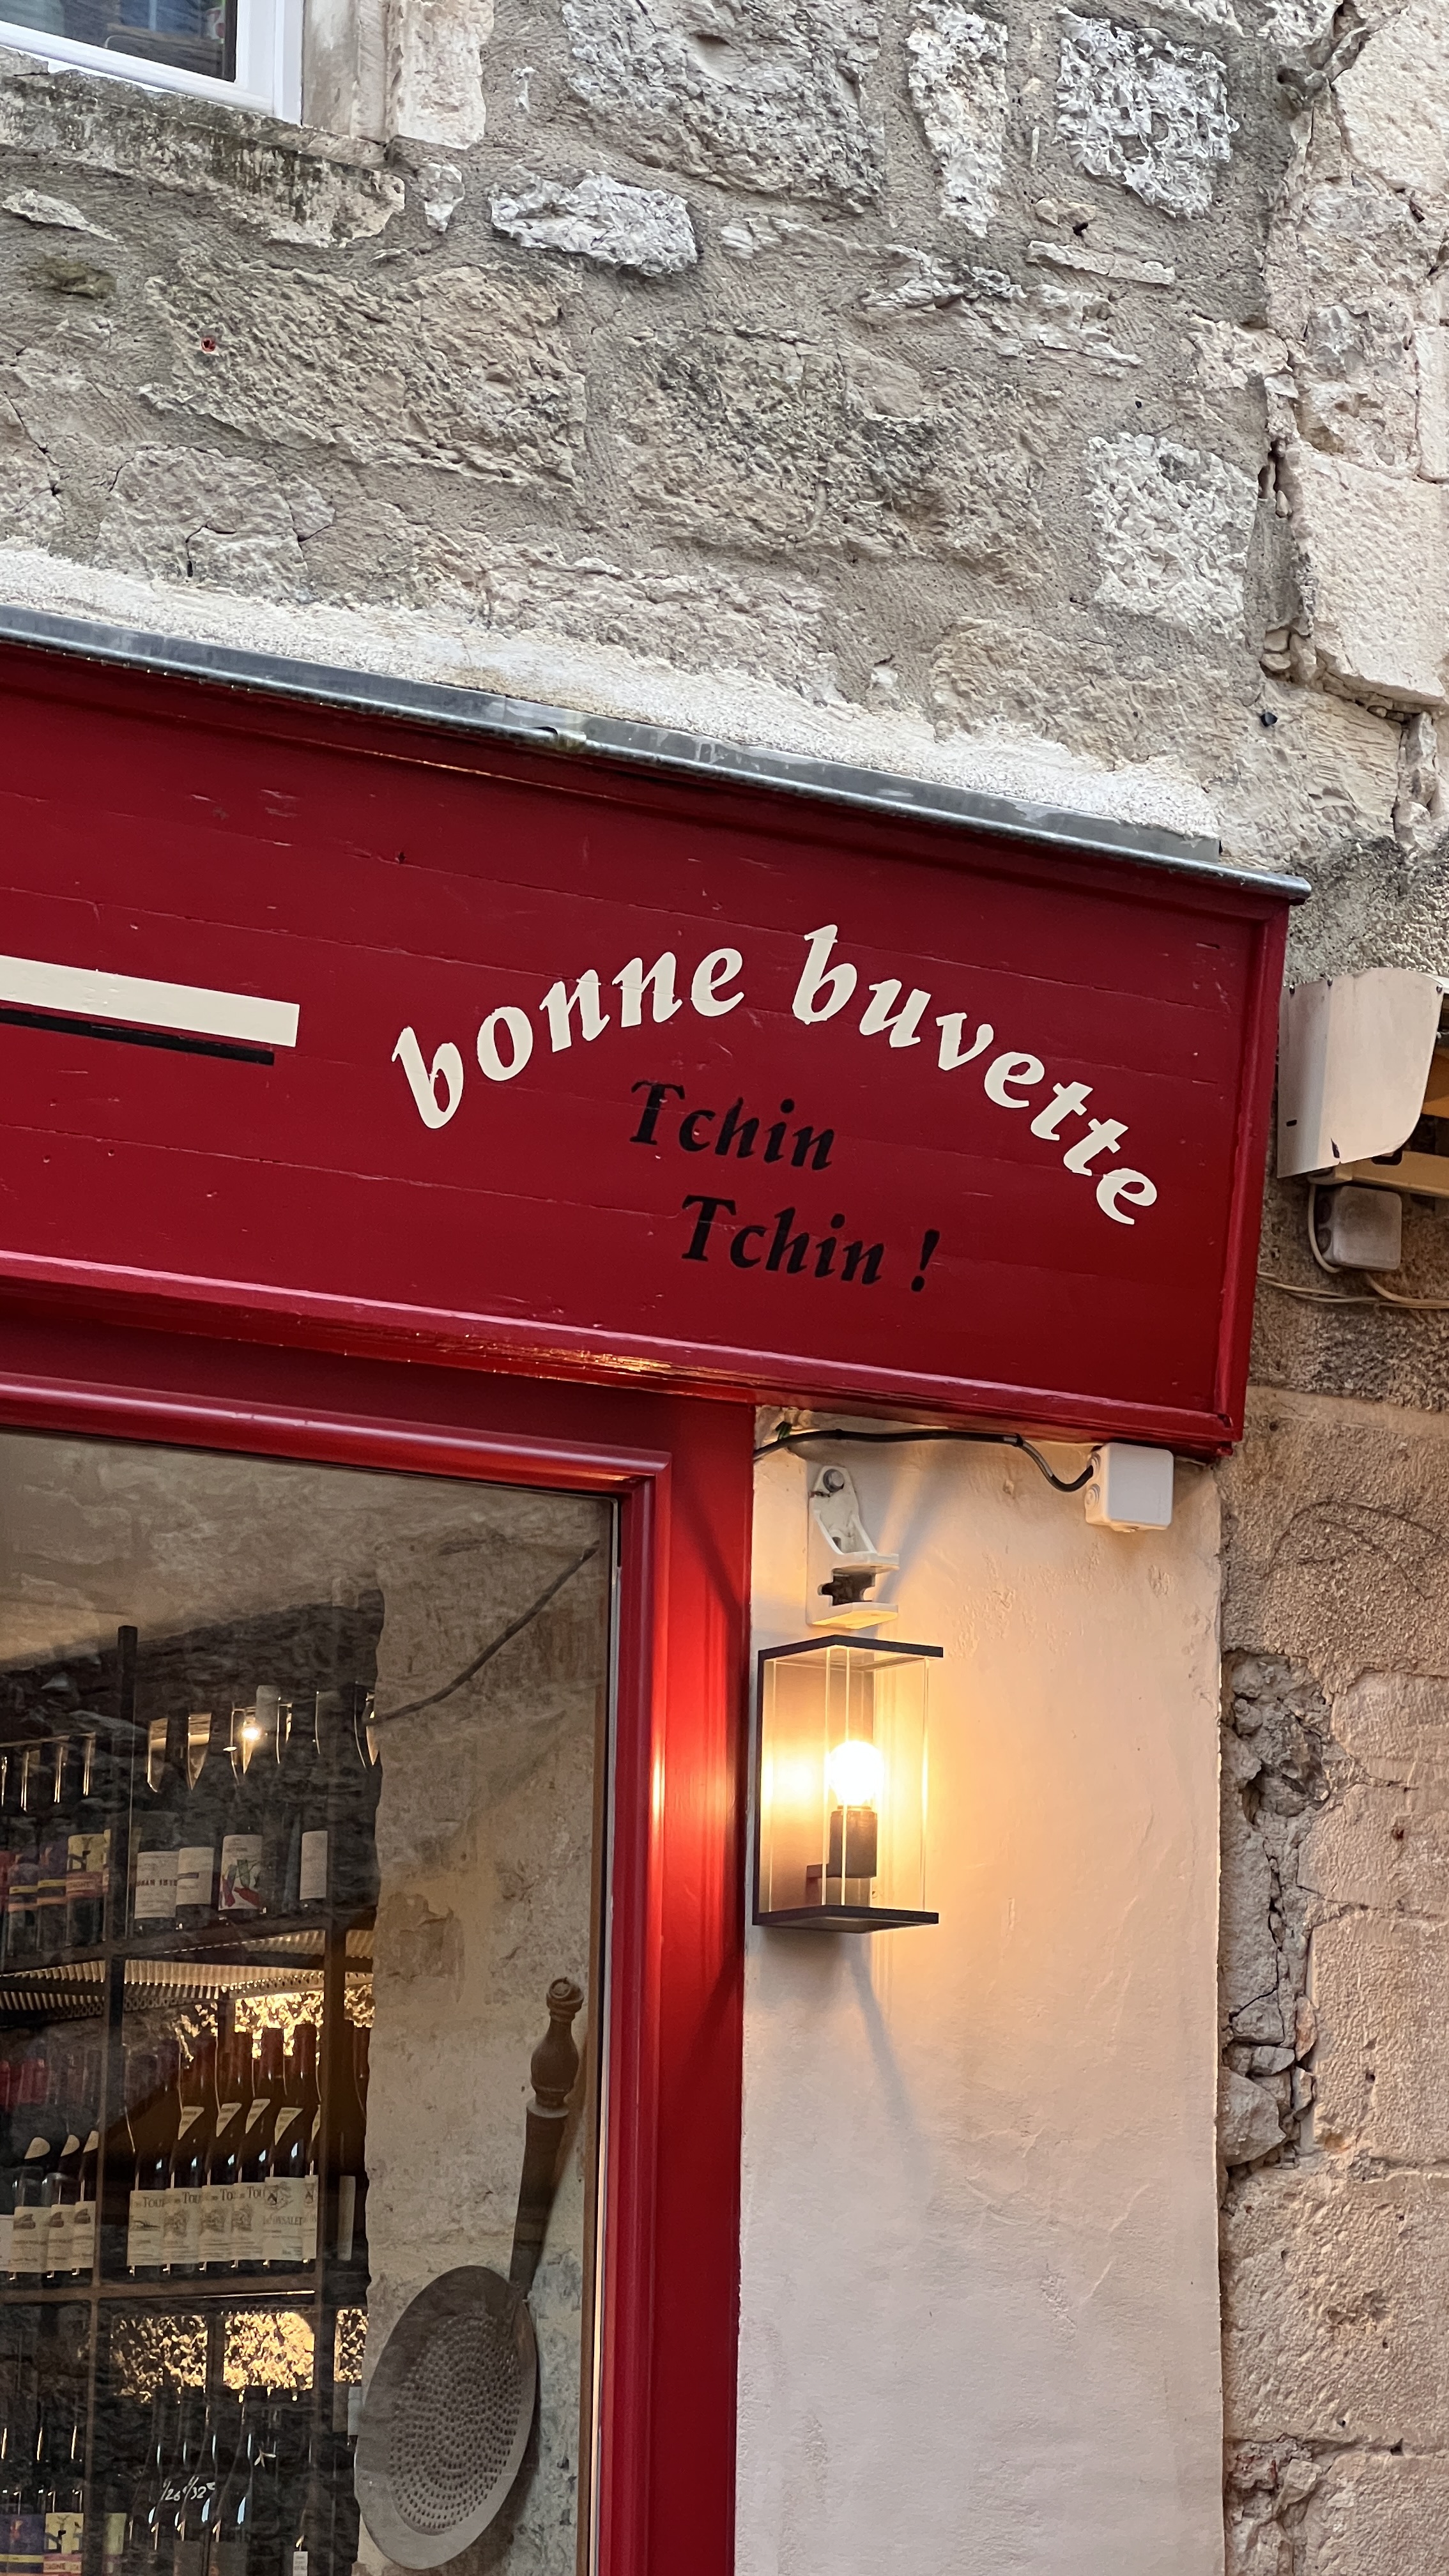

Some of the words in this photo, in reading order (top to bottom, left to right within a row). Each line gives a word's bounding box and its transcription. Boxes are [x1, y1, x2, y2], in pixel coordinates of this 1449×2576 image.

[392, 949, 744, 1128] bonne
[792, 924, 1156, 1224] buvette
[630, 1080, 834, 1170] Tchin
[682, 1195, 884, 1285] Tchin
[911, 1229, 940, 1292] !
